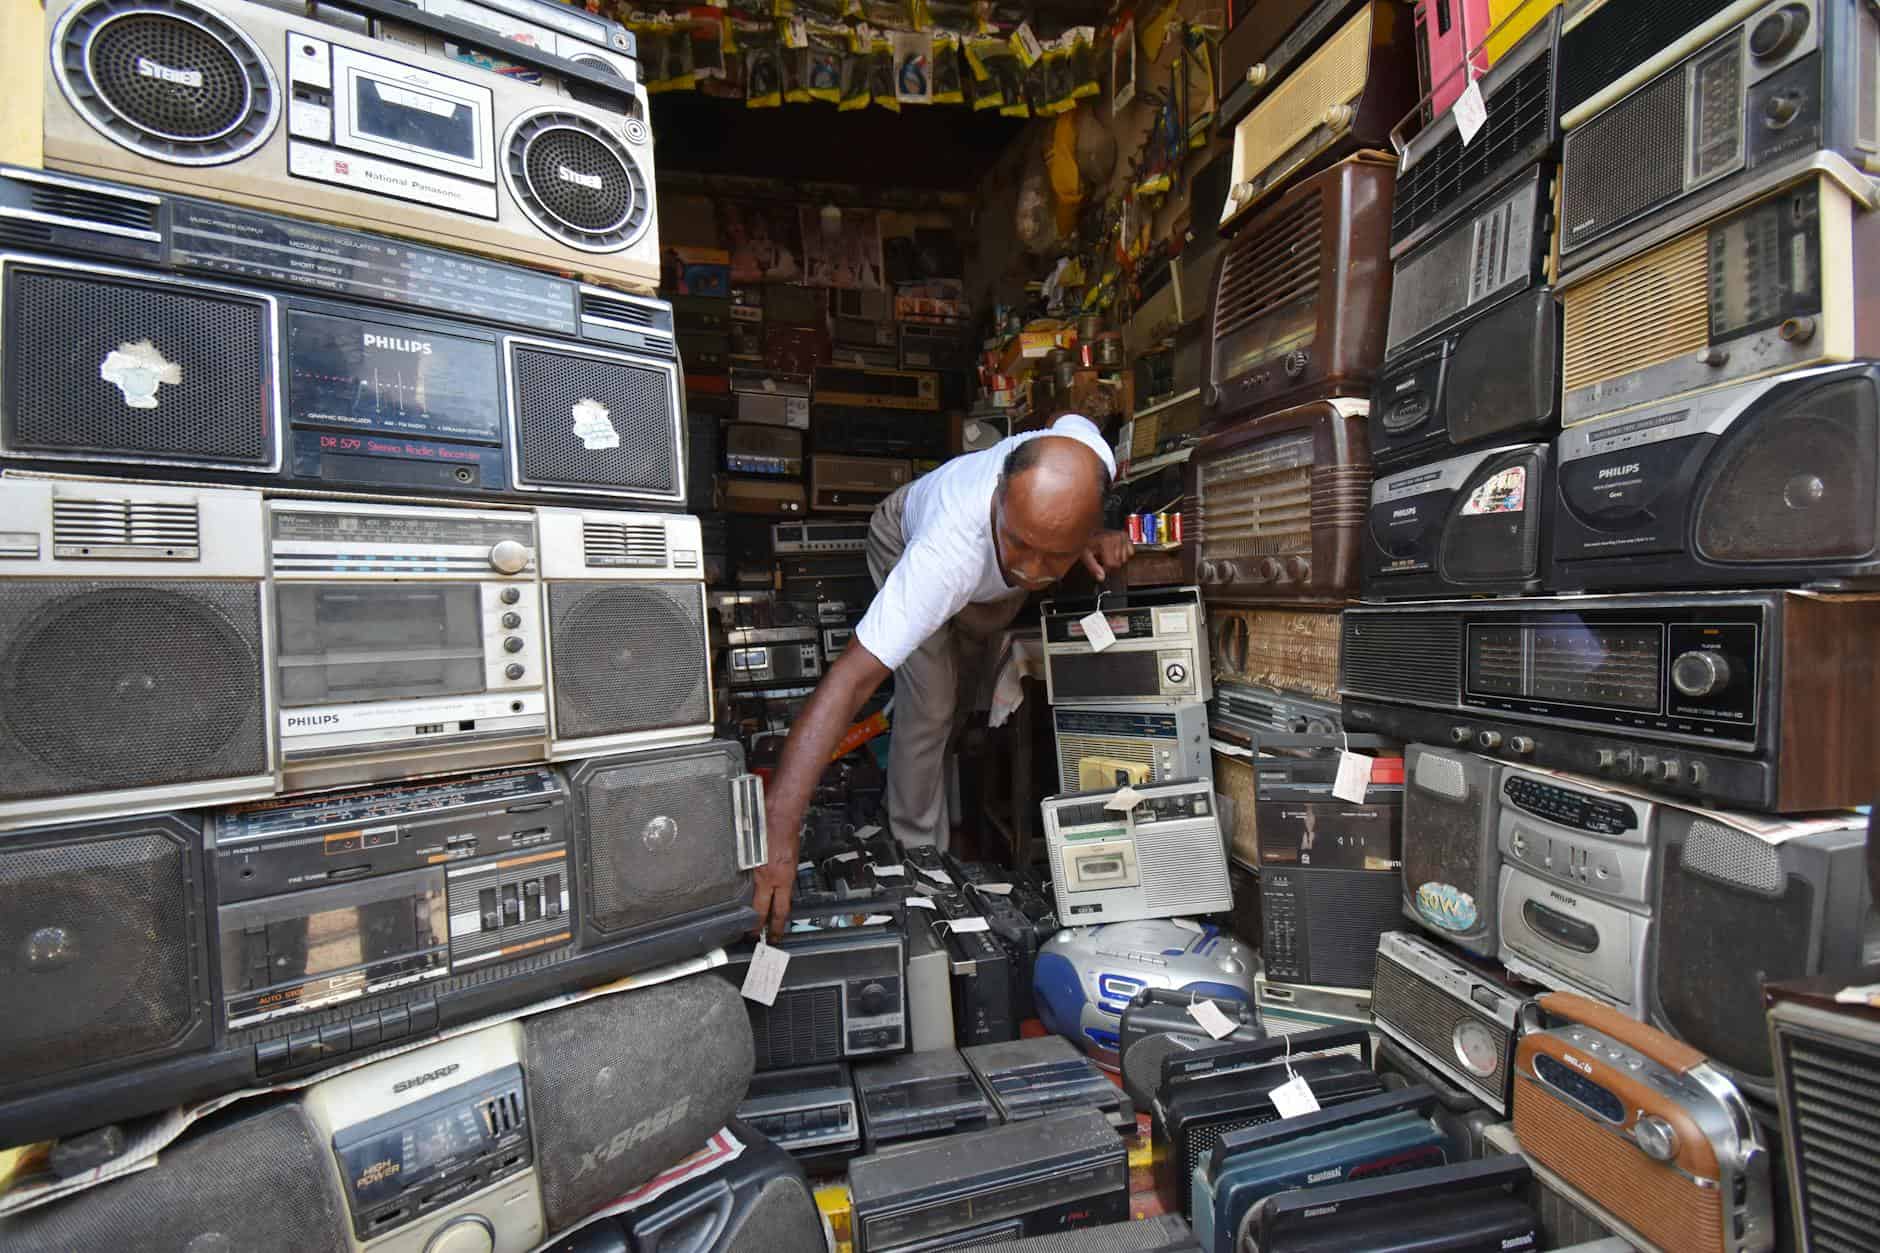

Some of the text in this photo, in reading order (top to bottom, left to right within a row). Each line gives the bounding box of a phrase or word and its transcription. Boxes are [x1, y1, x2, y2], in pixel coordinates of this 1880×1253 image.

[364, 170, 462, 199] National Panasonic
[363, 333, 433, 355] PHILIPS
[319, 436, 337, 448] DR
[340, 437, 362, 450] 579
[367, 440, 401, 453] Stereo
[405, 444, 434, 458] Radio
[1598, 463, 1641, 479] PHILIPS
[287, 713, 340, 728] PHILIPS
[259, 993, 282, 1005] AUTO
[392, 1063, 460, 1094] SHARP
[356, 1164, 401, 1190] POWER
